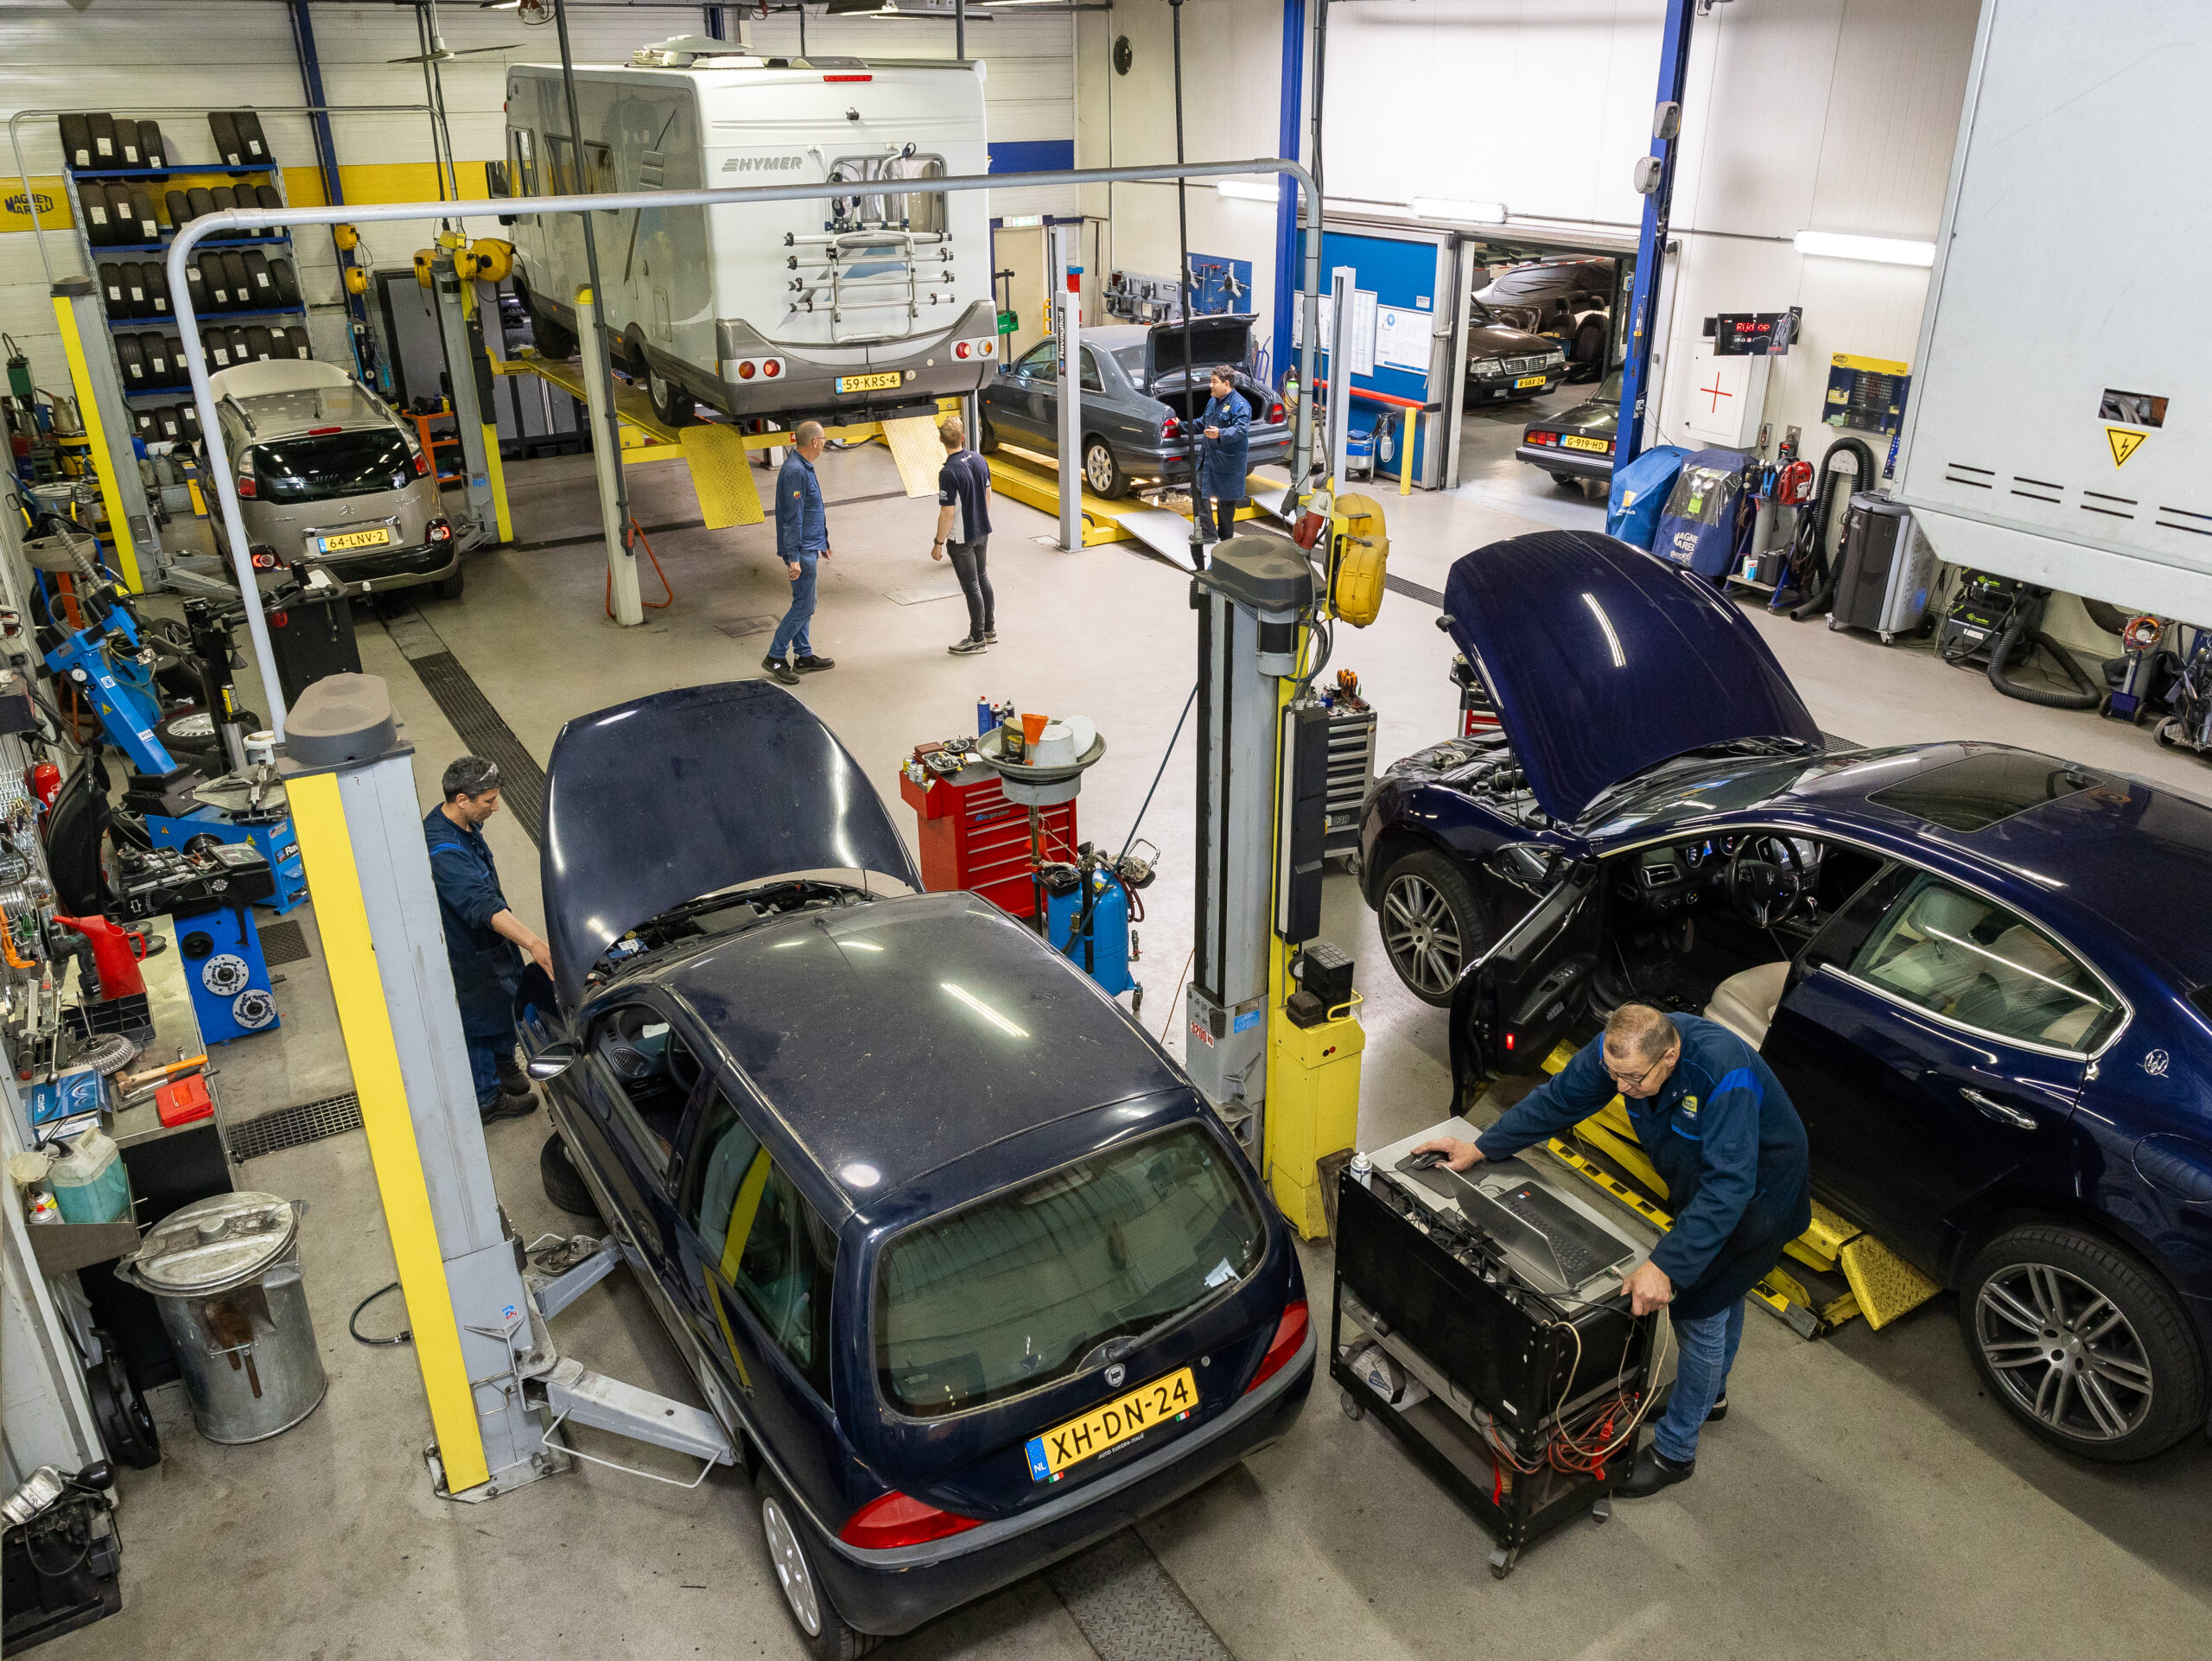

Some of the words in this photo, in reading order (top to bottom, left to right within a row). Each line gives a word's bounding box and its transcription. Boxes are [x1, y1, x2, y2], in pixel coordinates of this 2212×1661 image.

[737, 156, 804, 171] HYMER
[1736, 322, 1756, 333] Rijd
[1758, 323, 1770, 332] op
[844, 375, 897, 390] 59-KRS-4
[1567, 438, 1604, 450] G-919-HD
[330, 531, 385, 549] 64-LNV-2
[1191, 1021, 1207, 1043] 3200
[1051, 1377, 1189, 1466] XH-DN-24
[1097, 1449, 1112, 1461] AUTO
[1033, 1461, 1047, 1473] NL
